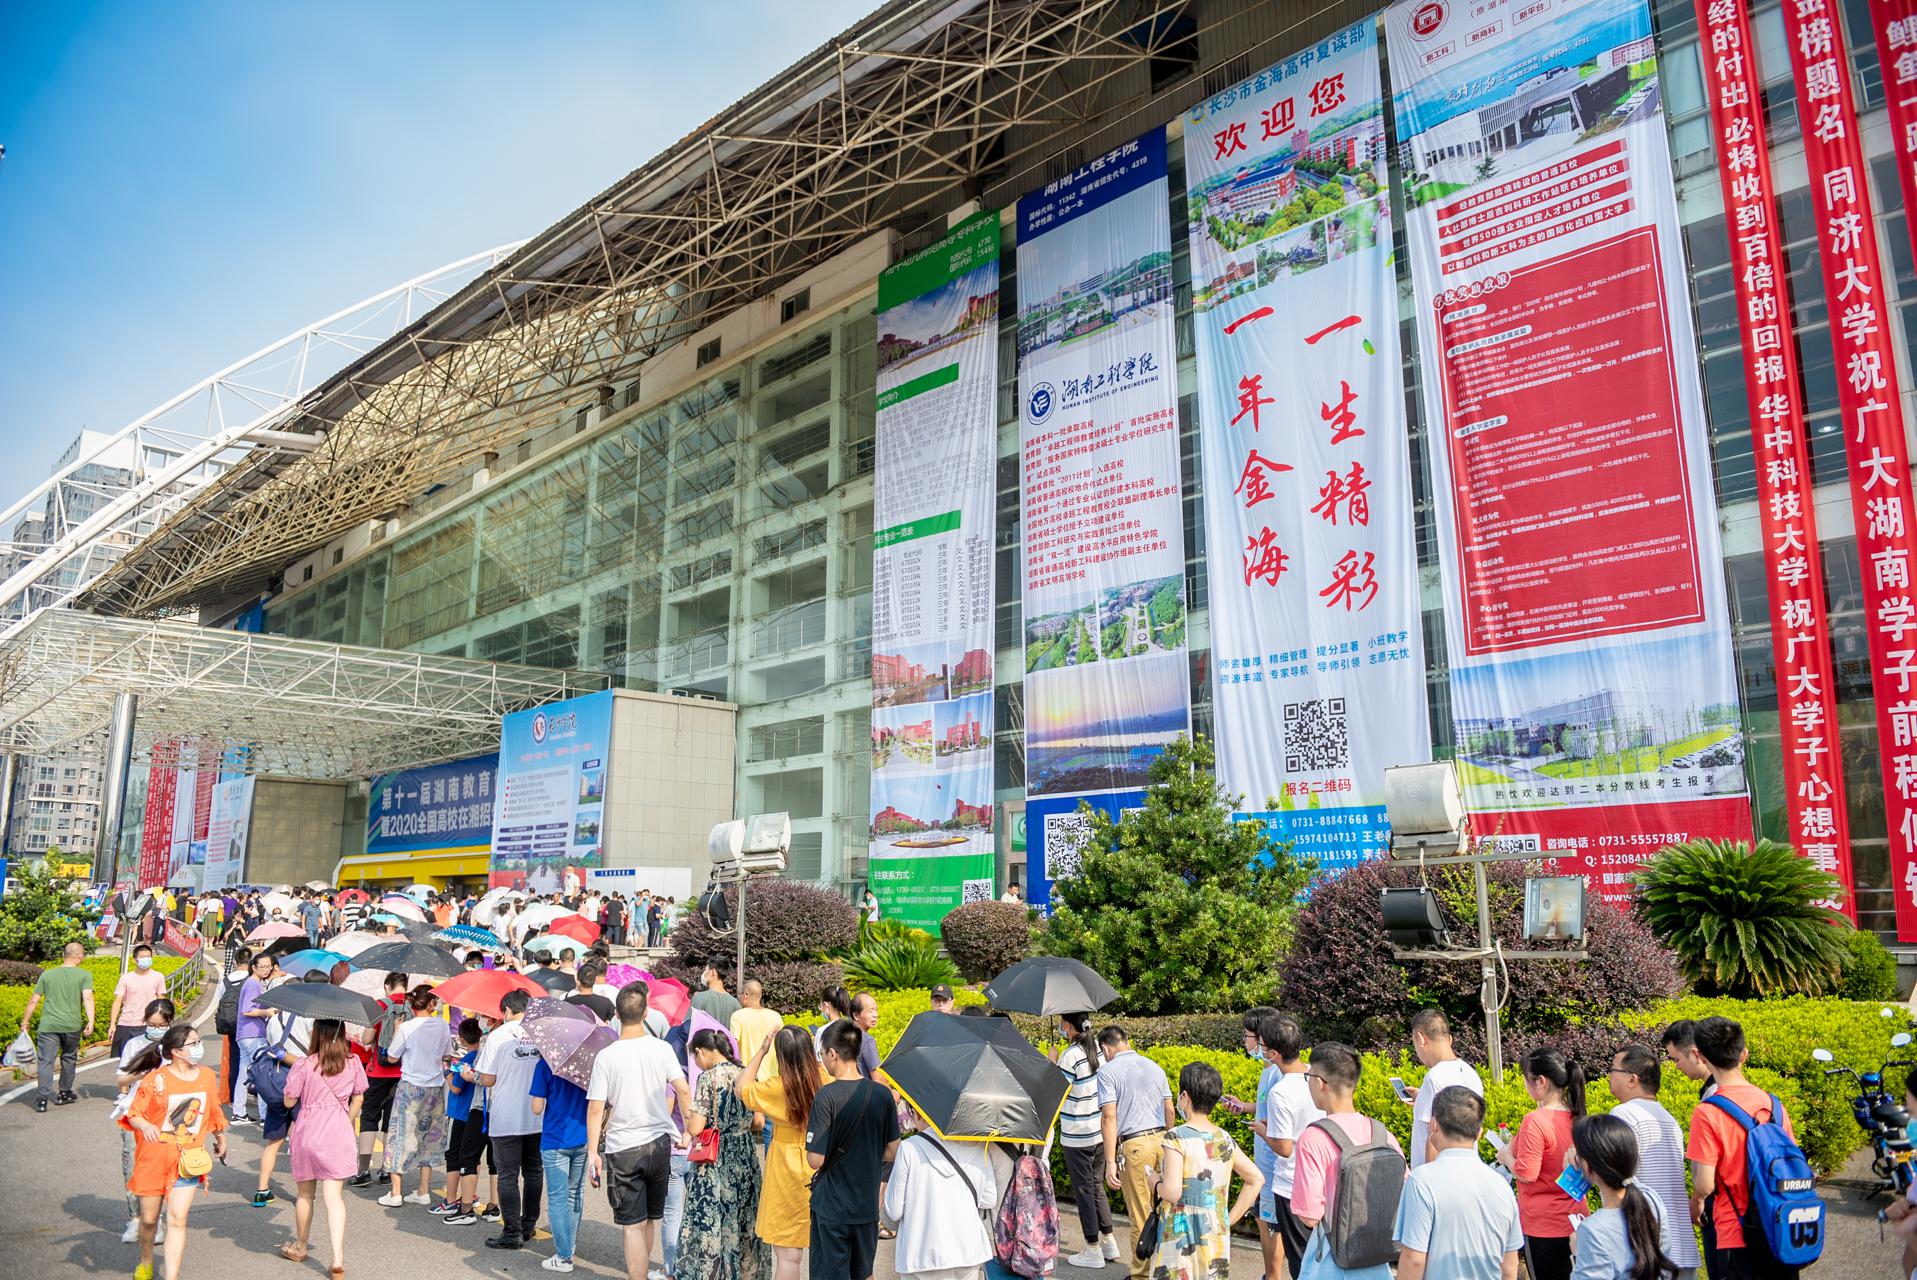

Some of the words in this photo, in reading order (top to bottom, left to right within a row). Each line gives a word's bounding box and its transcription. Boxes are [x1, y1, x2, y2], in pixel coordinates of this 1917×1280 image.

[1519, 3, 1544, 20] 新平台
[1471, 25, 1496, 42] 新商科
[1208, 23, 1365, 116] 长沙市金海高中复读部
[1425, 46, 1449, 64] 新工科
[1214, 72, 1346, 161] 欢迎您
[1061, 401, 1081, 411] HUNAN
[1082, 391, 1110, 405] INSTITUTE
[1111, 387, 1118, 395] OF
[1119, 374, 1159, 392] ENGINEERING
[1223, 306, 1294, 588] 一年金海
[1304, 315, 1379, 613] 一生精彩
[1219, 656, 1262, 670] 师资雄厚
[1269, 648, 1308, 665] 精细管理
[1316, 640, 1360, 656] 提分显著
[1368, 630, 1409, 649] 小班教学
[1219, 671, 1263, 685] 资源丰富
[1270, 665, 1309, 680] 专家导航
[1317, 657, 1361, 673] 导师引领
[1369, 647, 1411, 665] 志愿无忧
[381, 767, 499, 811] 第十一届湖南教育
[1285, 778, 1352, 796] 报名二维码
[1495, 774, 1716, 800] 热忱欢迎达到二本分数线考生报考
[1783, 1179, 1812, 1191] URBAN
